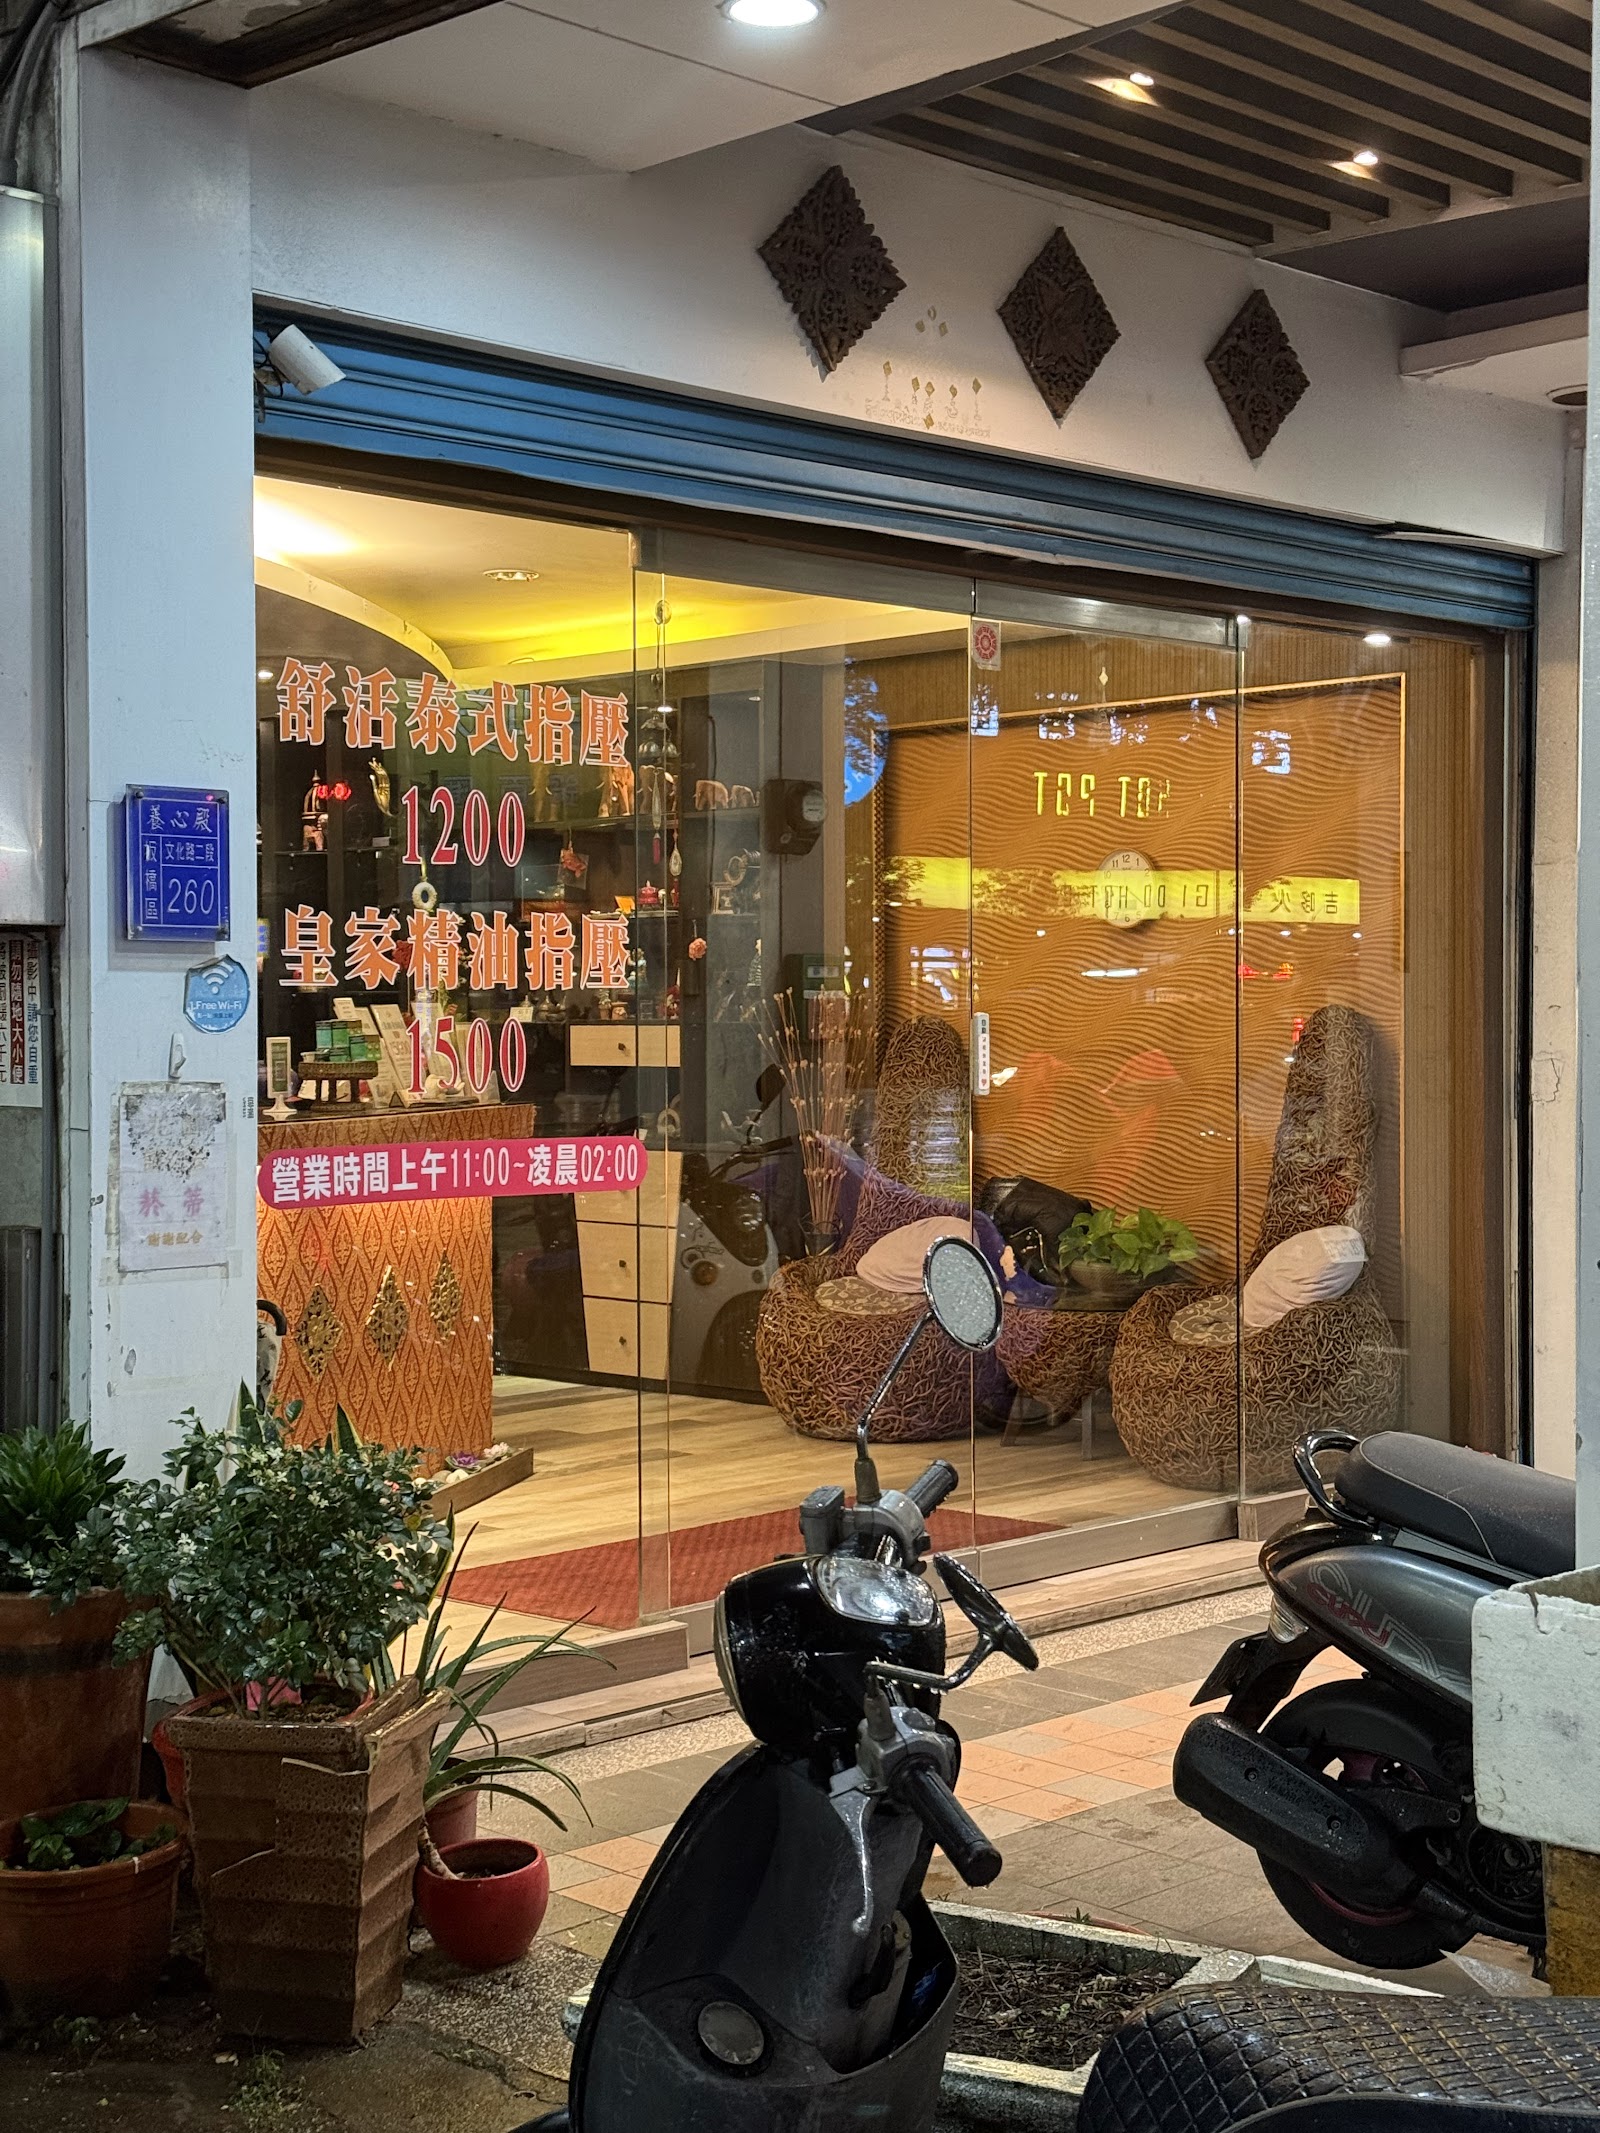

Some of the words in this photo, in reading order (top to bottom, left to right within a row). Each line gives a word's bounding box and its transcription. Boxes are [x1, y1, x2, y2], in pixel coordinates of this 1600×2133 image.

[276, 657, 630, 767] 舒活泰式指壓
[147, 804, 213, 833] 養心殿
[165, 841, 215, 862] 文化路二段
[401, 785, 526, 868] 1200
[144, 840, 159, 920] 板橋區
[167, 878, 215, 915] 260
[278, 905, 630, 991] 皇家精油指壓
[11, 941, 24, 1085] 請勿隨地大小便
[405, 1016, 527, 1096] 1500
